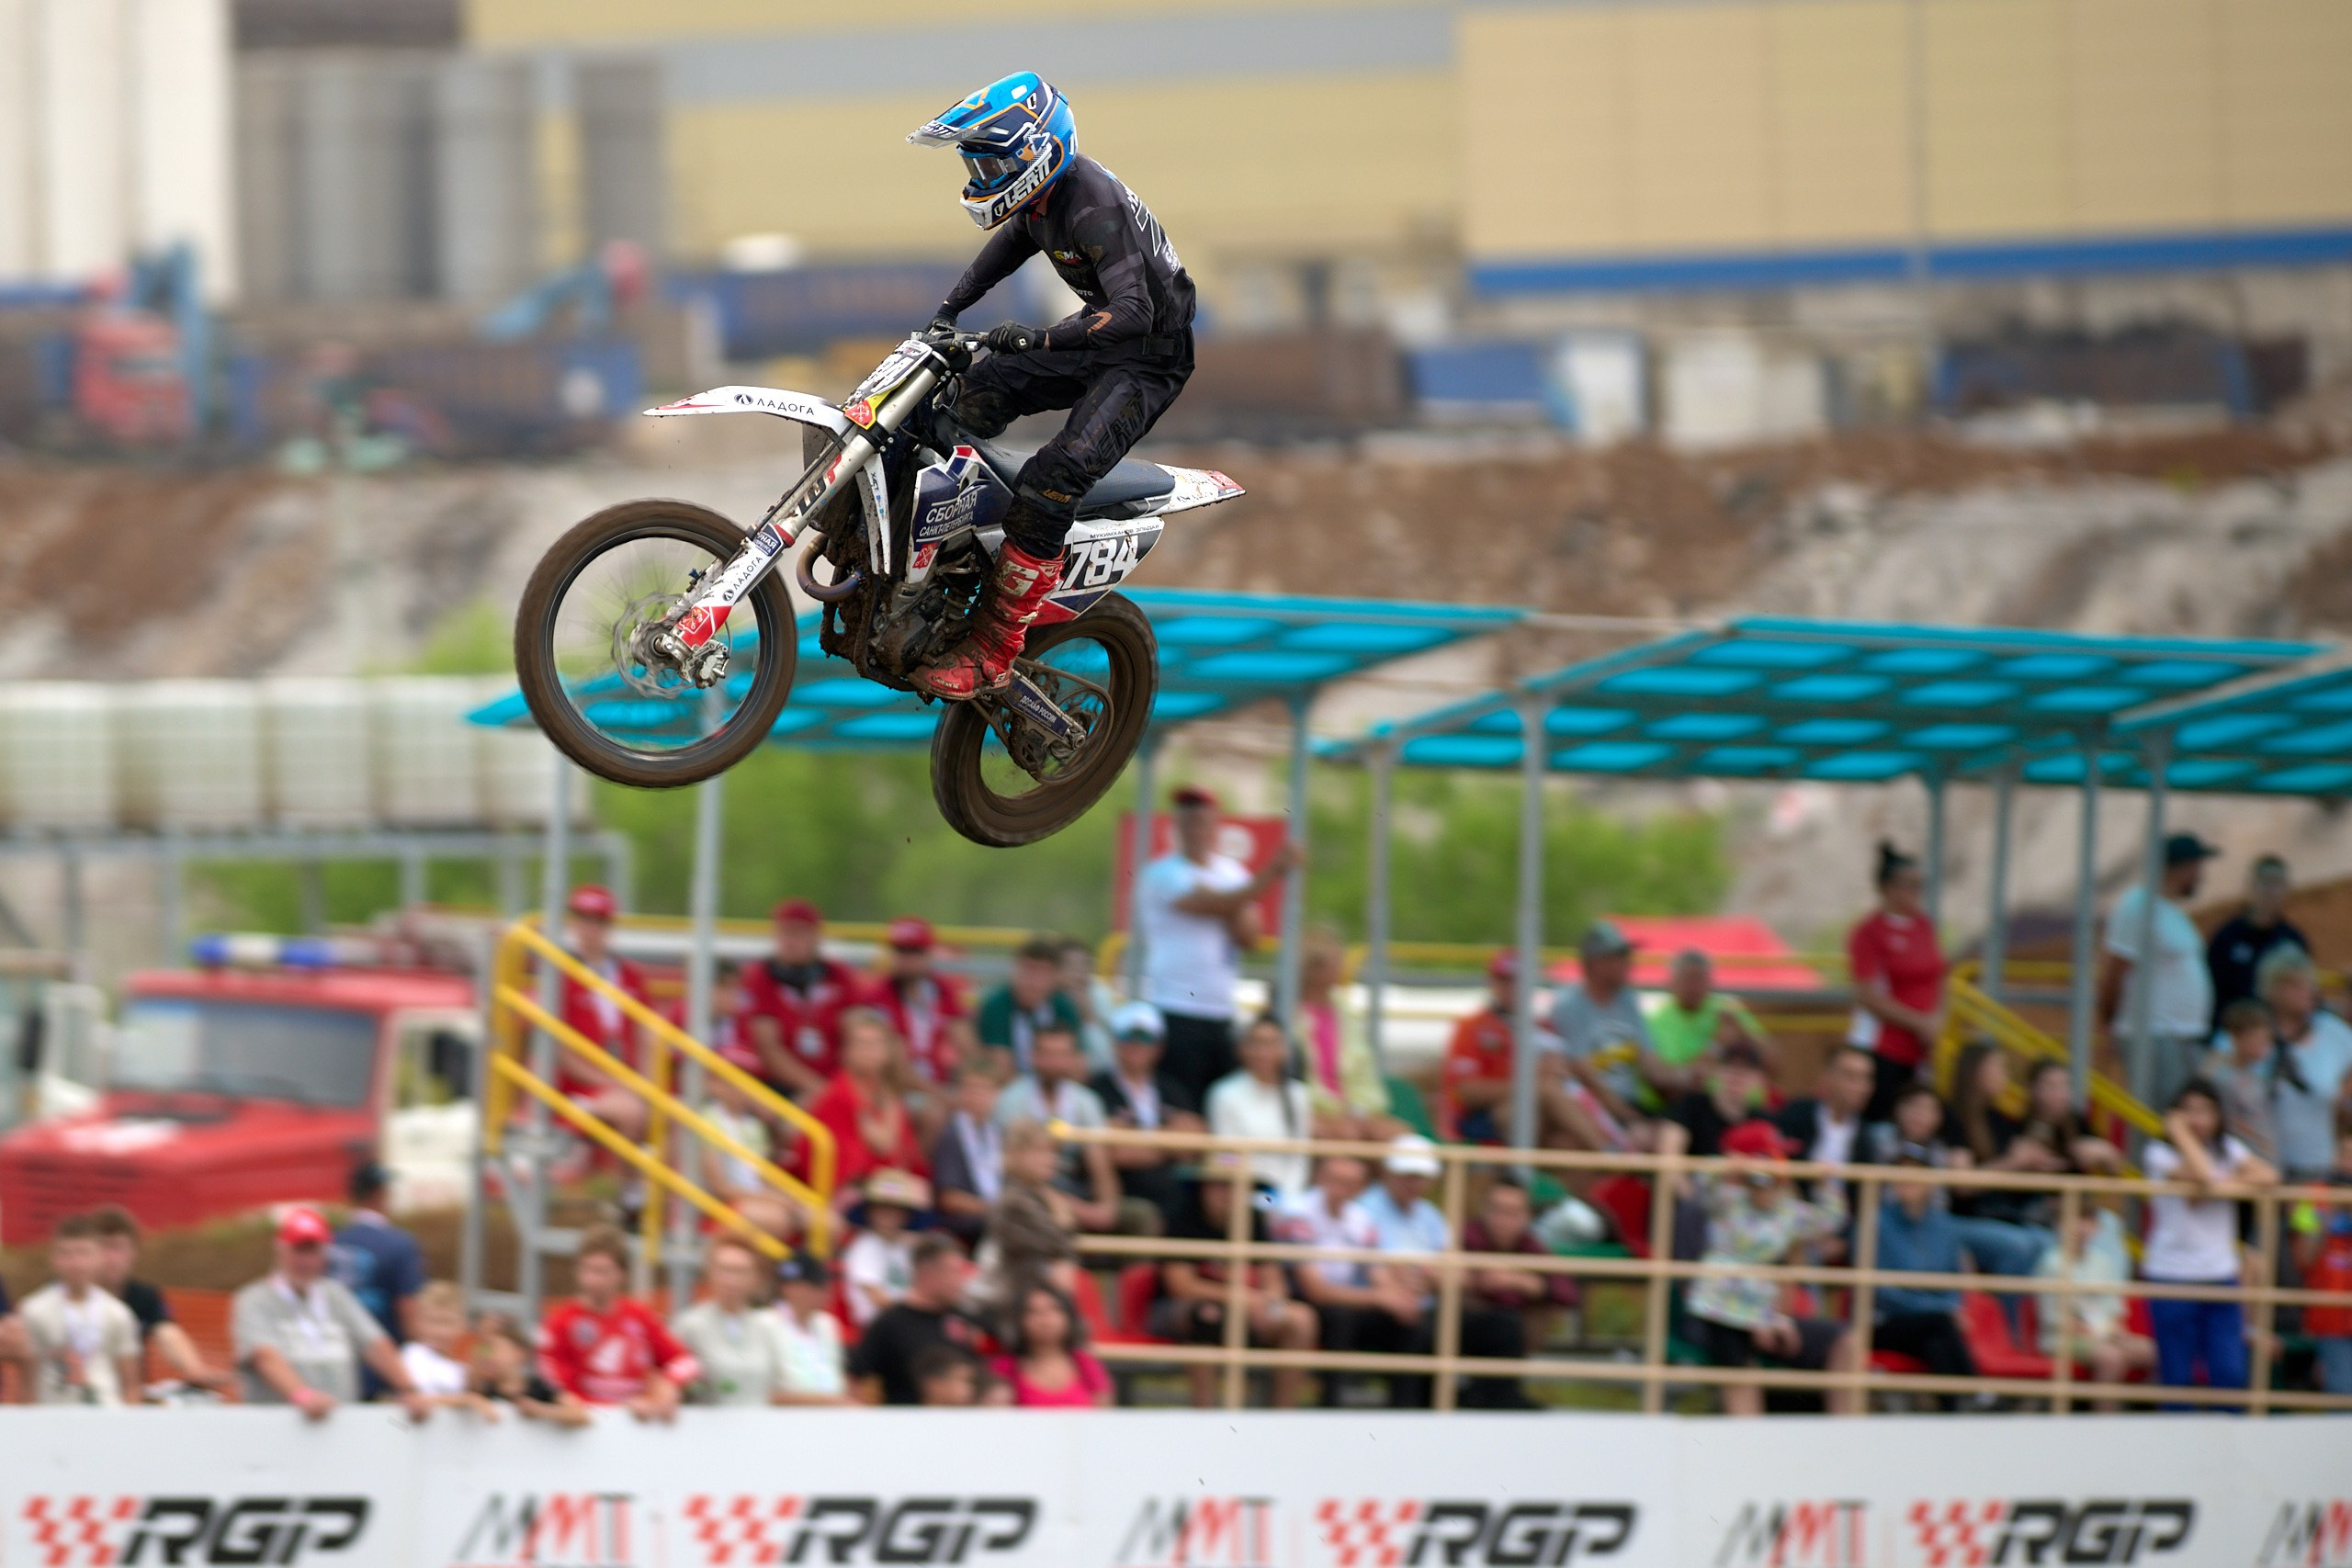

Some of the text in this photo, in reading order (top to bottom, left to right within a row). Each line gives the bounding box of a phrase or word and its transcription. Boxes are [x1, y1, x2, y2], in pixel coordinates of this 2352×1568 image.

[1004, 152, 1052, 209] LEATT
[757, 398, 814, 415] ЛАДОГА
[925, 491, 978, 525] СБОРНАЯ
[733, 556, 763, 590] ЛАДОГА
[1061, 535, 1139, 590] 784
[1038, 706, 1057, 724] РОССИИ
[120, 1496, 373, 1567] RGP
[786, 1496, 1039, 1565] RGP
[1405, 1500, 1636, 1566] RGP
[1990, 1501, 2198, 1567] RGP
[2253, 1498, 2352, 1568] MM
